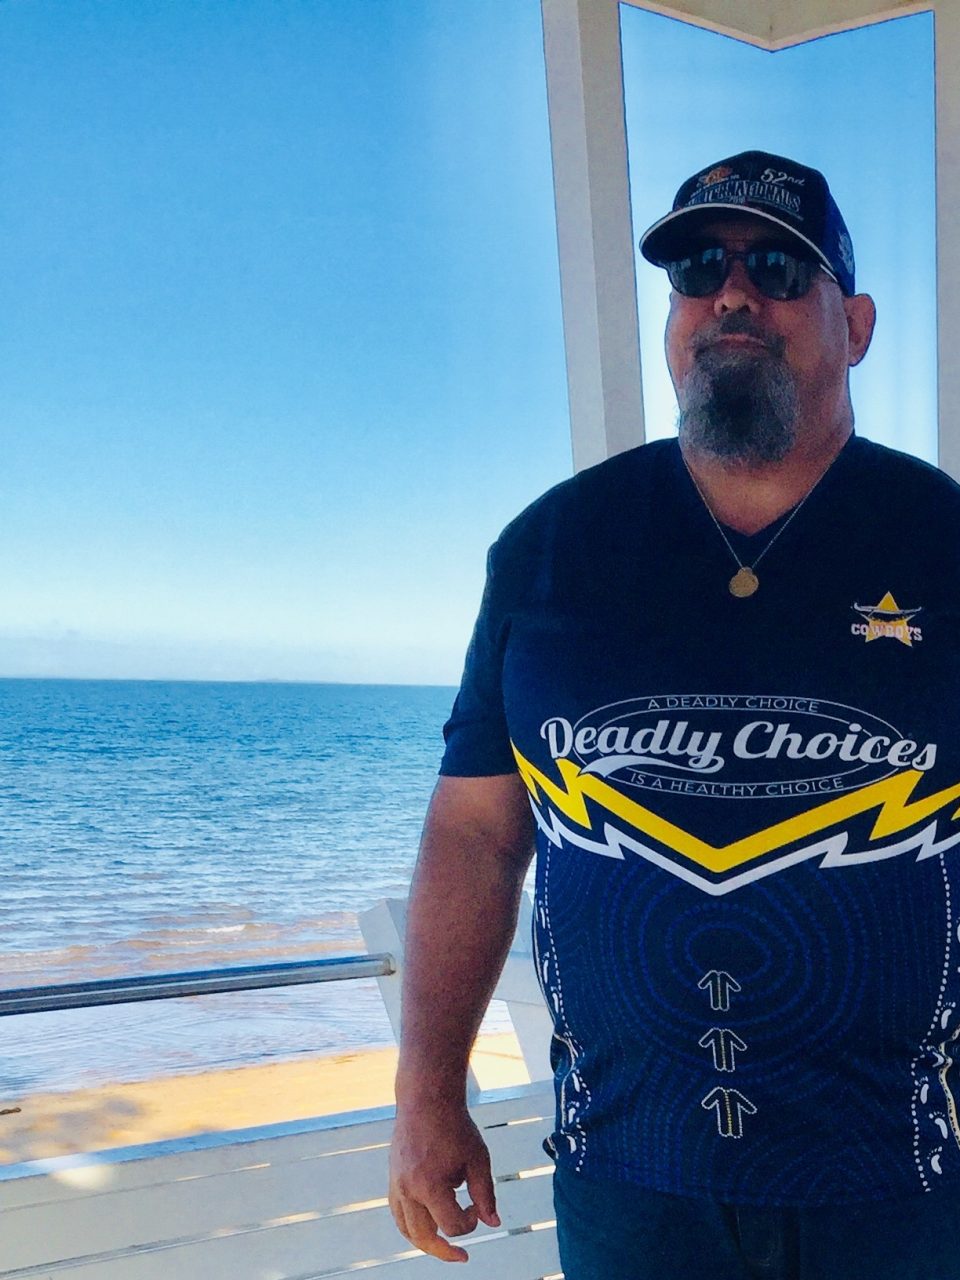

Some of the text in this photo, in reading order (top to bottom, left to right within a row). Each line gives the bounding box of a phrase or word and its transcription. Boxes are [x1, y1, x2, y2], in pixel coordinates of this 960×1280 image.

[760, 168, 806, 187] 52nd
[851, 623, 923, 641] COWBOYS
[647, 696, 820, 713] A DEADLY CHOICE
[540, 716, 938, 777] Deadly Choices
[630, 772, 845, 797] IS A HEALTHY CHOICE
